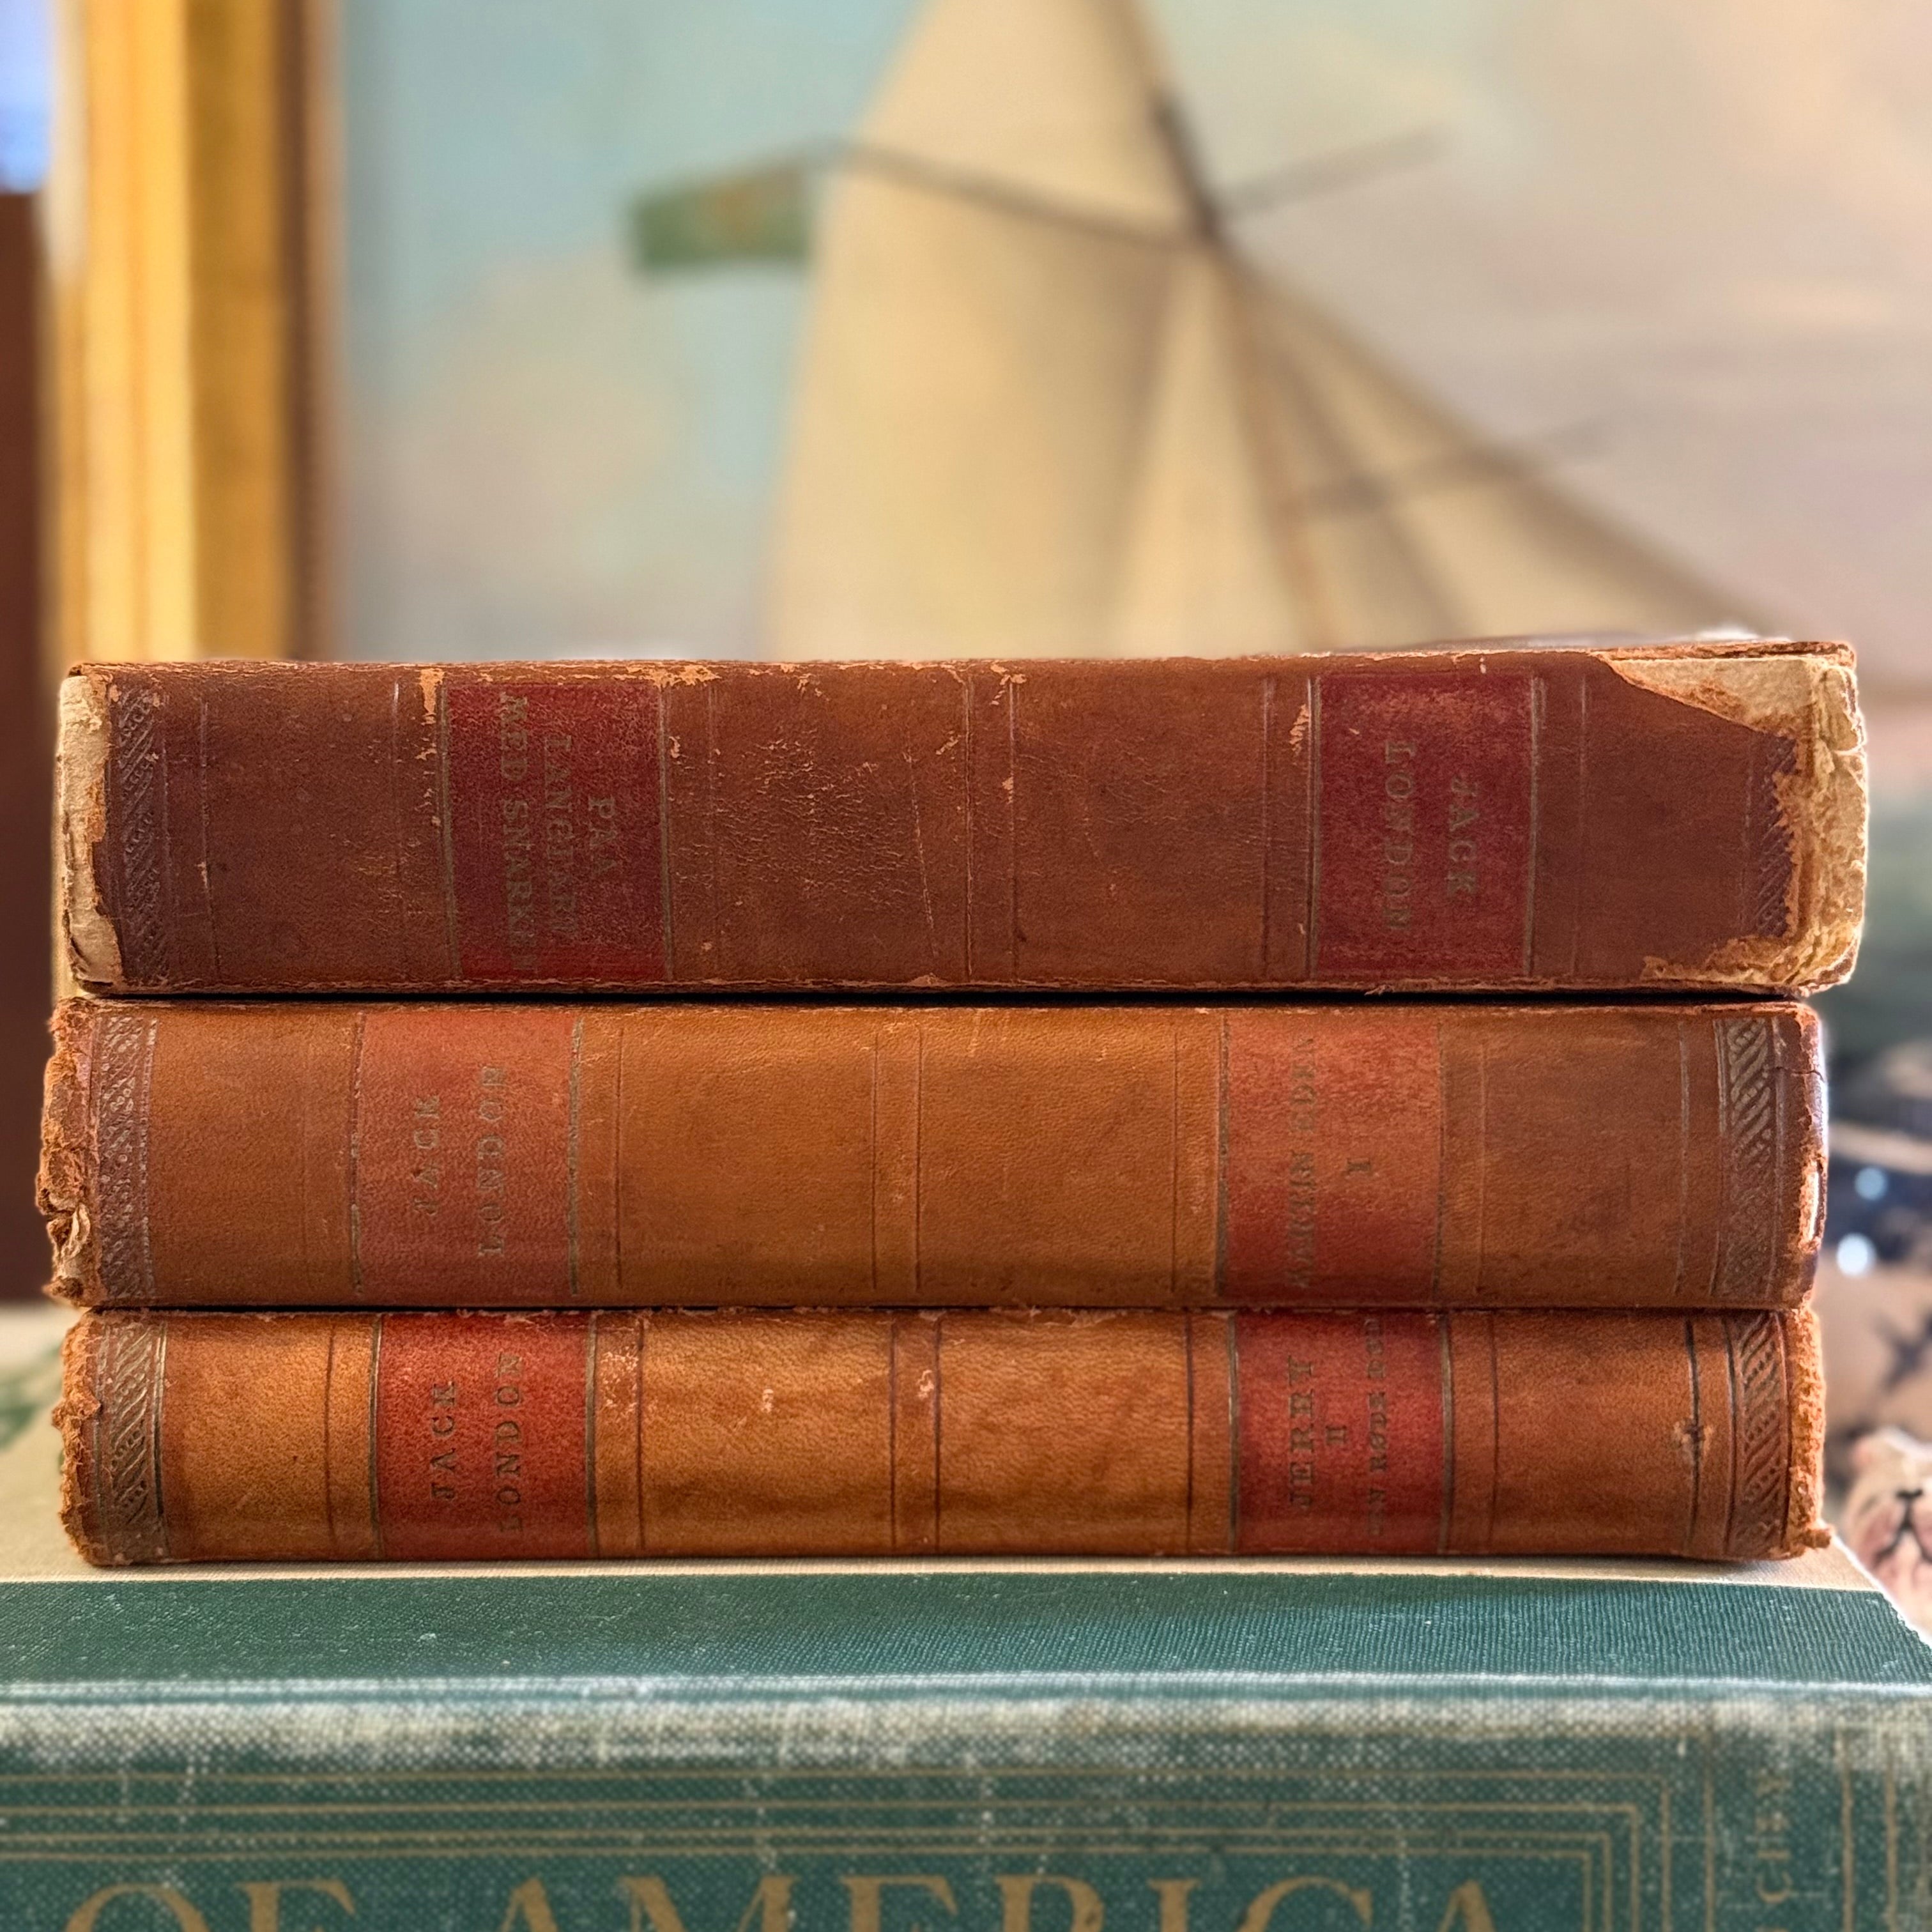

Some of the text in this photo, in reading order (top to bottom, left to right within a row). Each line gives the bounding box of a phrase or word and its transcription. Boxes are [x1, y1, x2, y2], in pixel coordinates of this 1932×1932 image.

[1383, 739, 1416, 932] LONDON
[1446, 775, 1480, 897] JACK
[411, 1094, 441, 1216] JACK
[477, 1064, 505, 1257] LONDON
[429, 1380, 456, 1502] JACK
[494, 1352, 524, 1534] LONDON
[1288, 1355, 1315, 1508] JERRY
